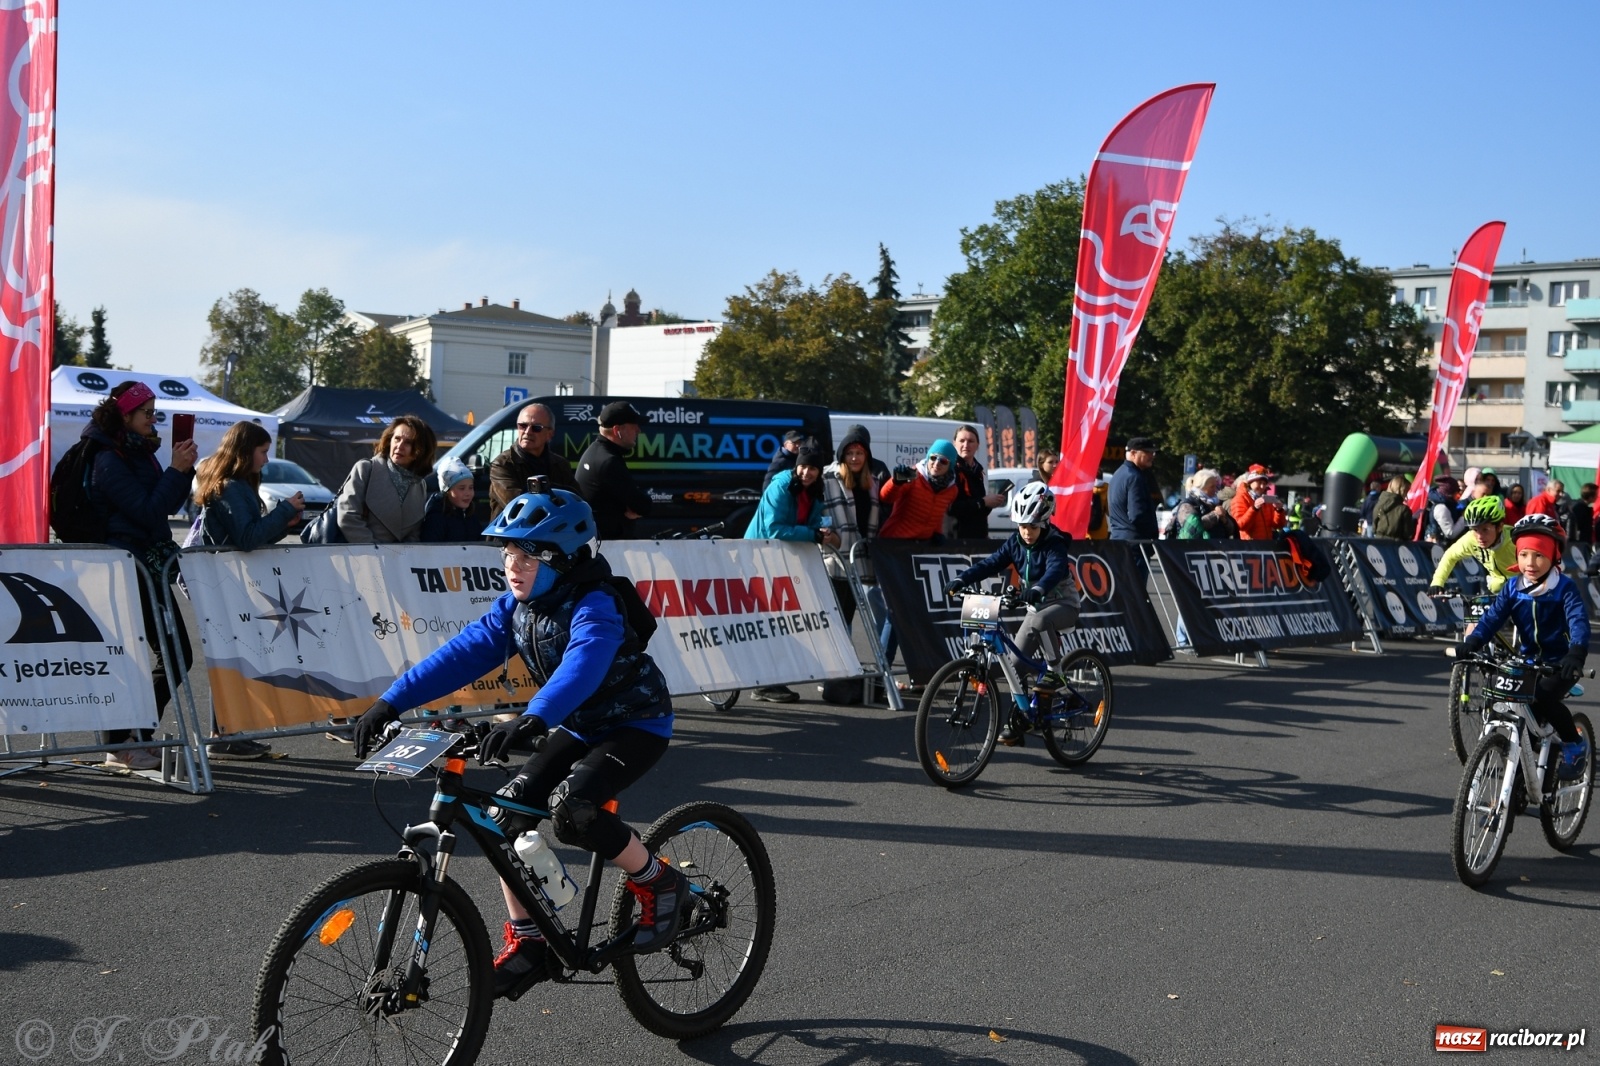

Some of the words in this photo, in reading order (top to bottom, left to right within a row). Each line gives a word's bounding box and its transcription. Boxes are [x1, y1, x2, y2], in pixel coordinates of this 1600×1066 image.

[646, 406, 704, 424] atelier
[272, 566, 282, 576] N
[248, 580, 262, 588] NW
[302, 576, 312, 585] NE
[411, 566, 508, 594] TAURUS
[239, 612, 251, 623] W
[323, 606, 331, 616] E
[970, 607, 991, 620] 298
[679, 626, 723, 652] TAKE
[722, 620, 769, 646] MORE
[768, 610, 829, 641] FRIENDS
[1282, 611, 1340, 636] NAJLEPSZYCH
[263, 646, 275, 655] SW
[297, 654, 304, 664] S
[14, 658, 110, 683] jedziesz
[1496, 676, 1524, 692] 257
[0, 692, 116, 707] www.taurus.info.pl
[384, 744, 427, 760] 267
[500, 843, 565, 935] KROSS
